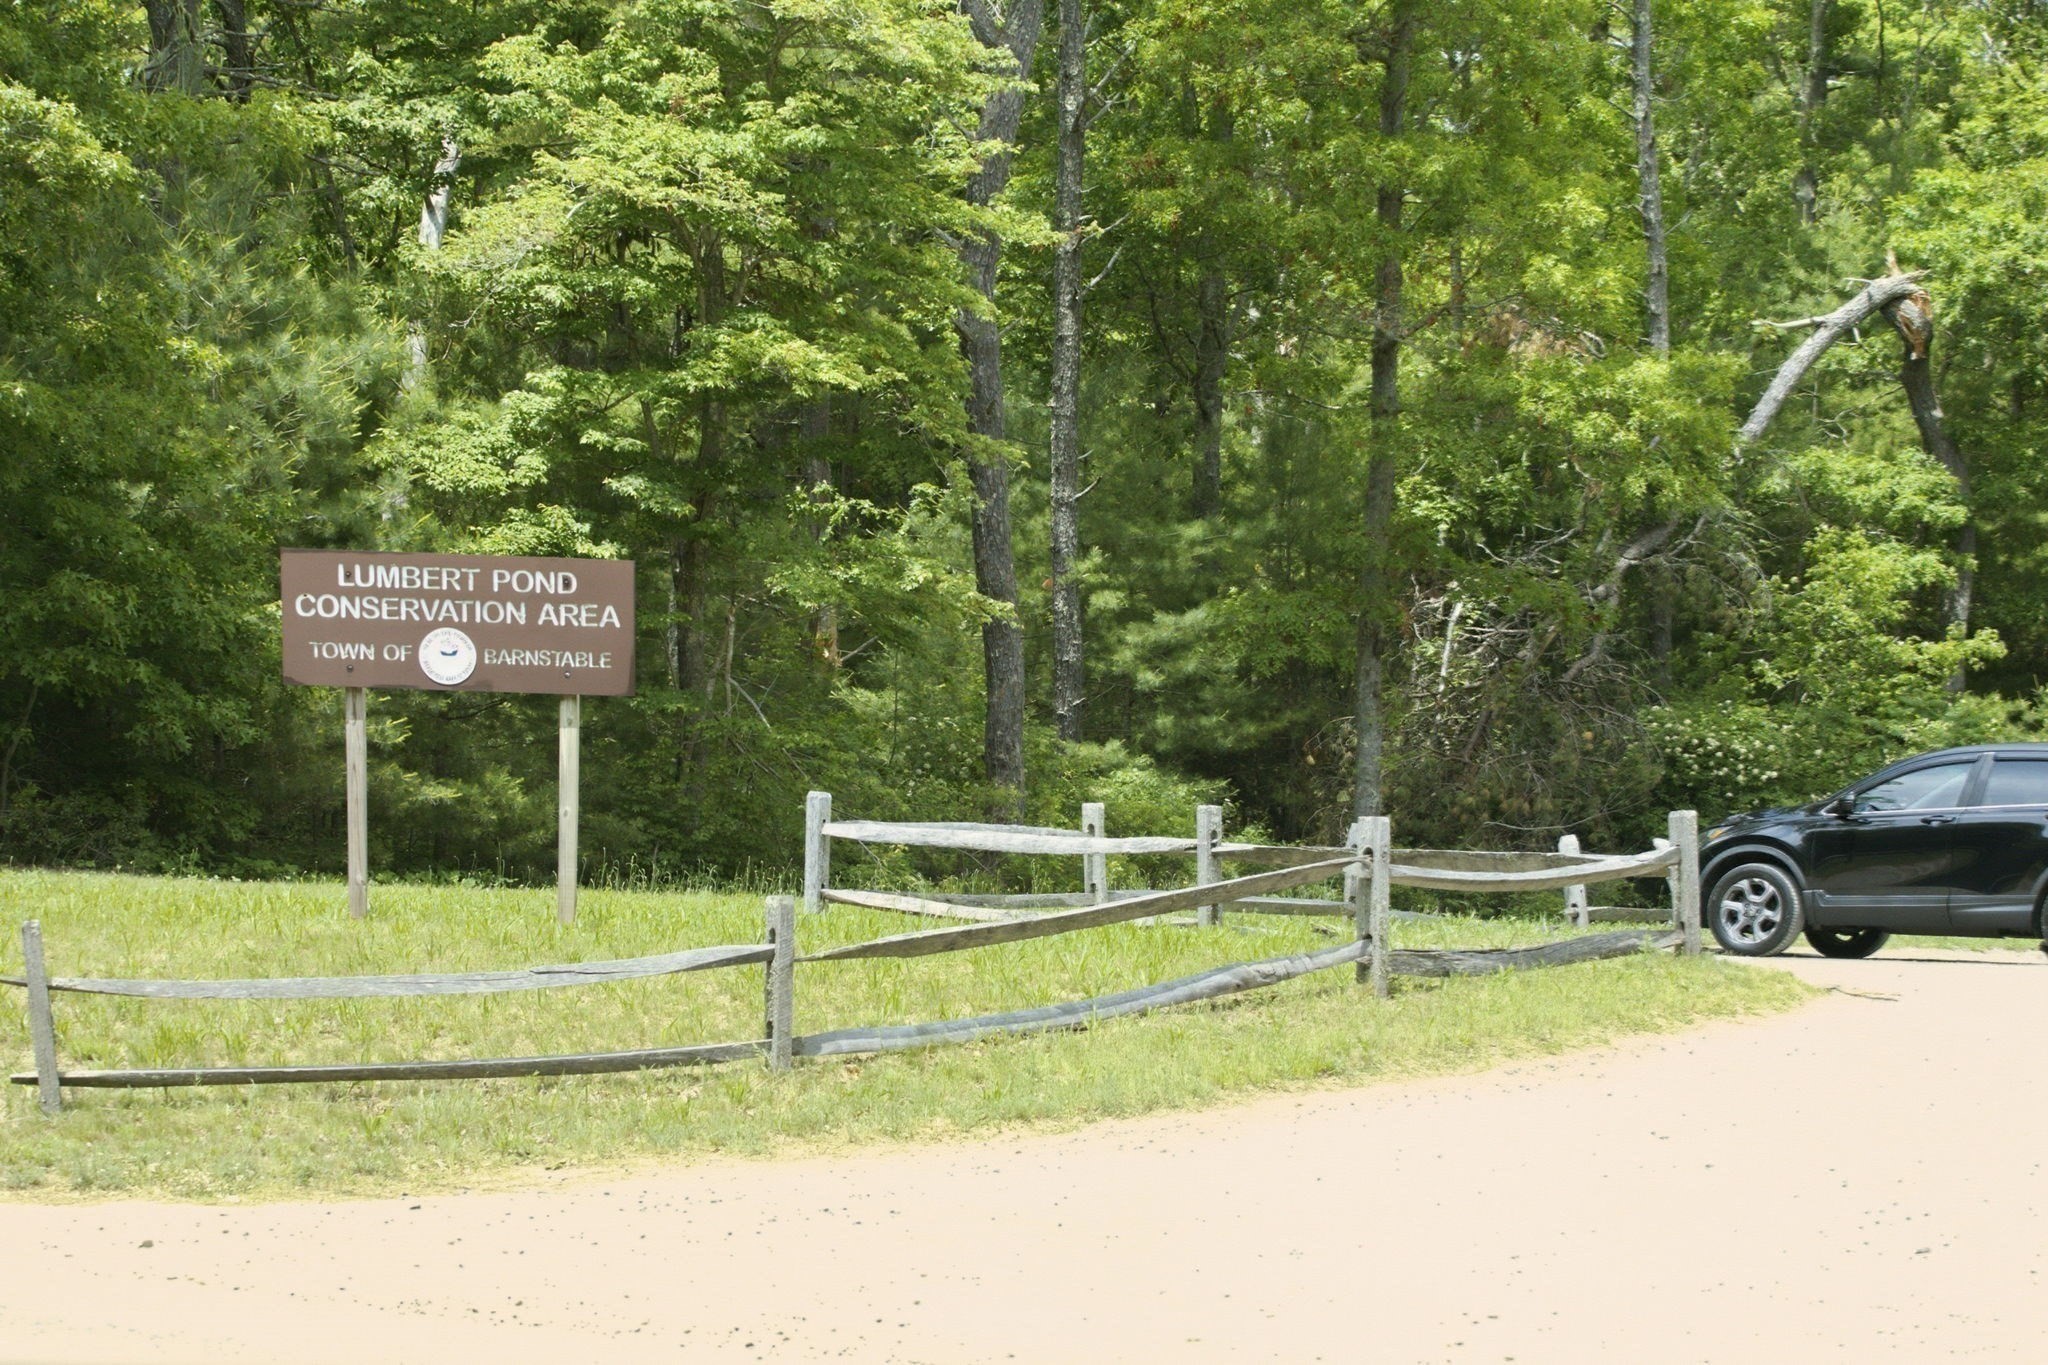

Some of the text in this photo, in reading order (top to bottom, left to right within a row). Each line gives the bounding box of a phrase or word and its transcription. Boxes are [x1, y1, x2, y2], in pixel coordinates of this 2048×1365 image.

[338, 563, 577, 594] LUMBERT POND
[295, 593, 620, 628] CONSERVATION AREA
[309, 641, 612, 668] TOWN OF BARNSTABLE
